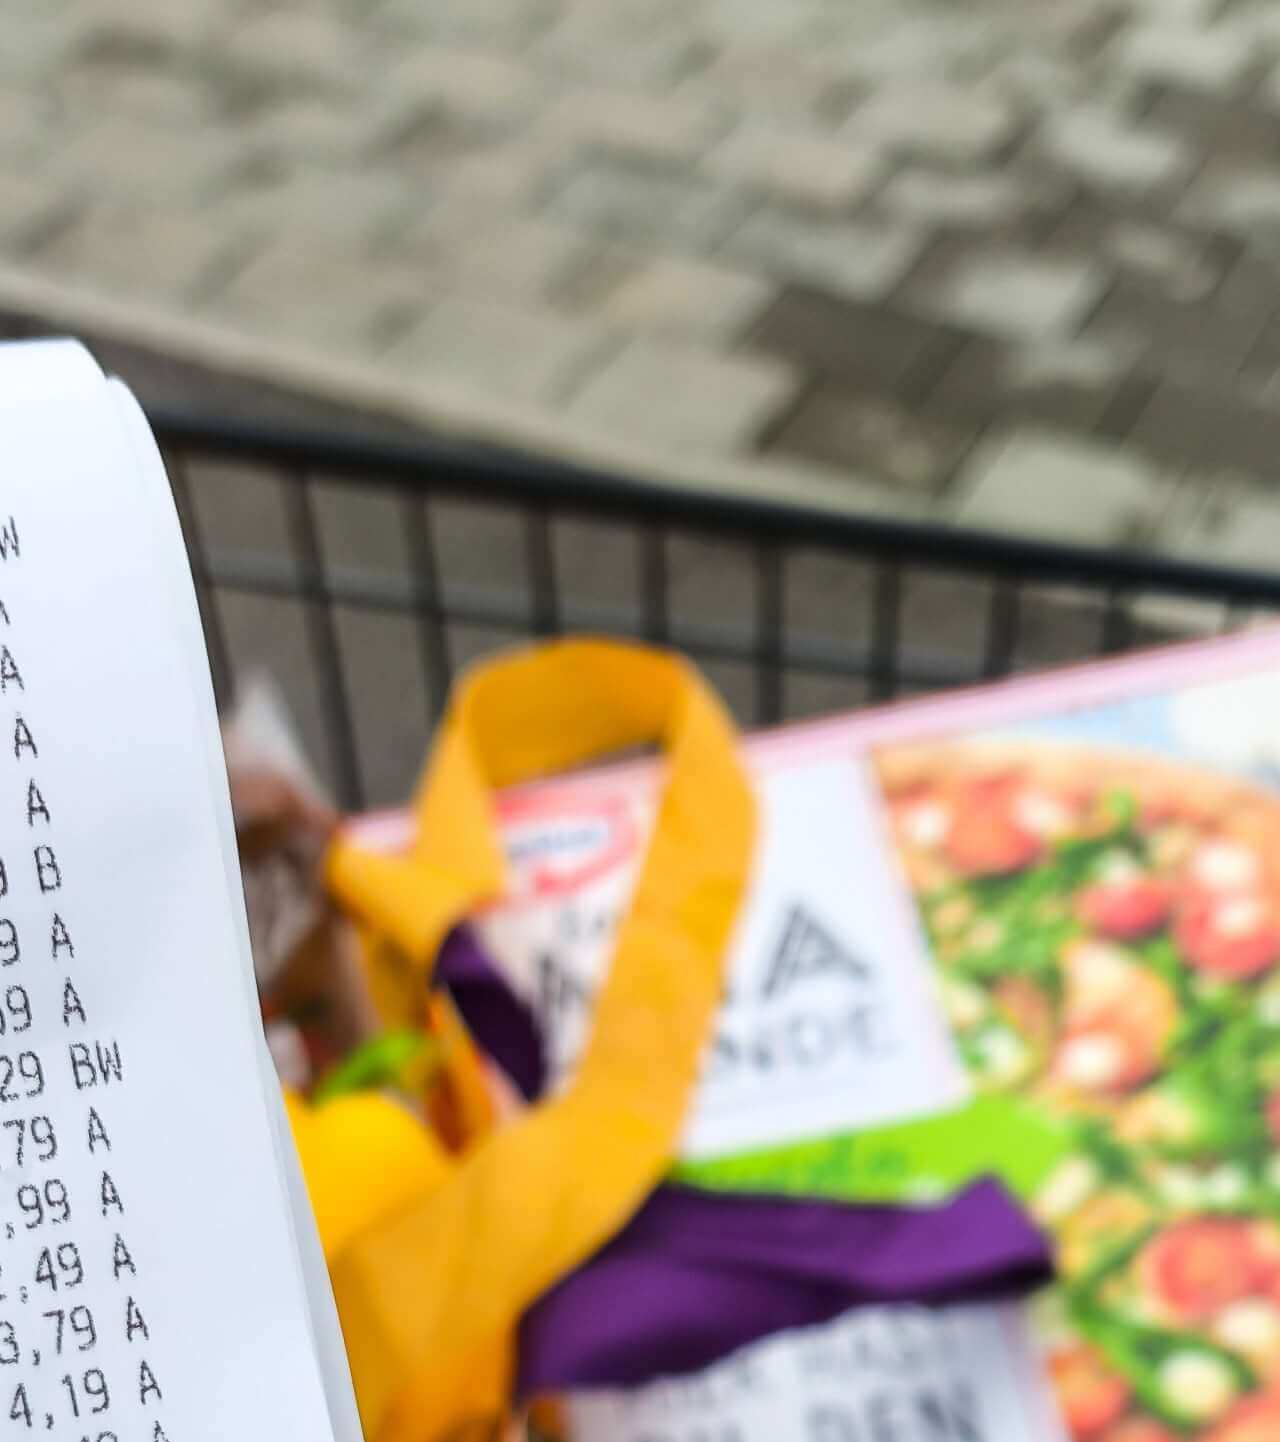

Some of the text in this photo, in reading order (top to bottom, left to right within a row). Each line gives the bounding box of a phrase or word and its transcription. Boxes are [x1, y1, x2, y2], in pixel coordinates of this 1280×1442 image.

[0, 645, 25, 693] A
[14, 717, 38, 760] A
[27, 778, 51, 827] A
[35, 845, 62, 894] B
[51, 912, 74, 960] A
[62, 977, 86, 1027] A
[71, 1040, 123, 1090] BW
[88, 1106, 112, 1153] A
[101, 1170, 124, 1217] A
[112, 1233, 136, 1280] A
[124, 1296, 149, 1342] A
[9, 1368, 111, 1430] 4,19
[139, 1360, 163, 1405] A
